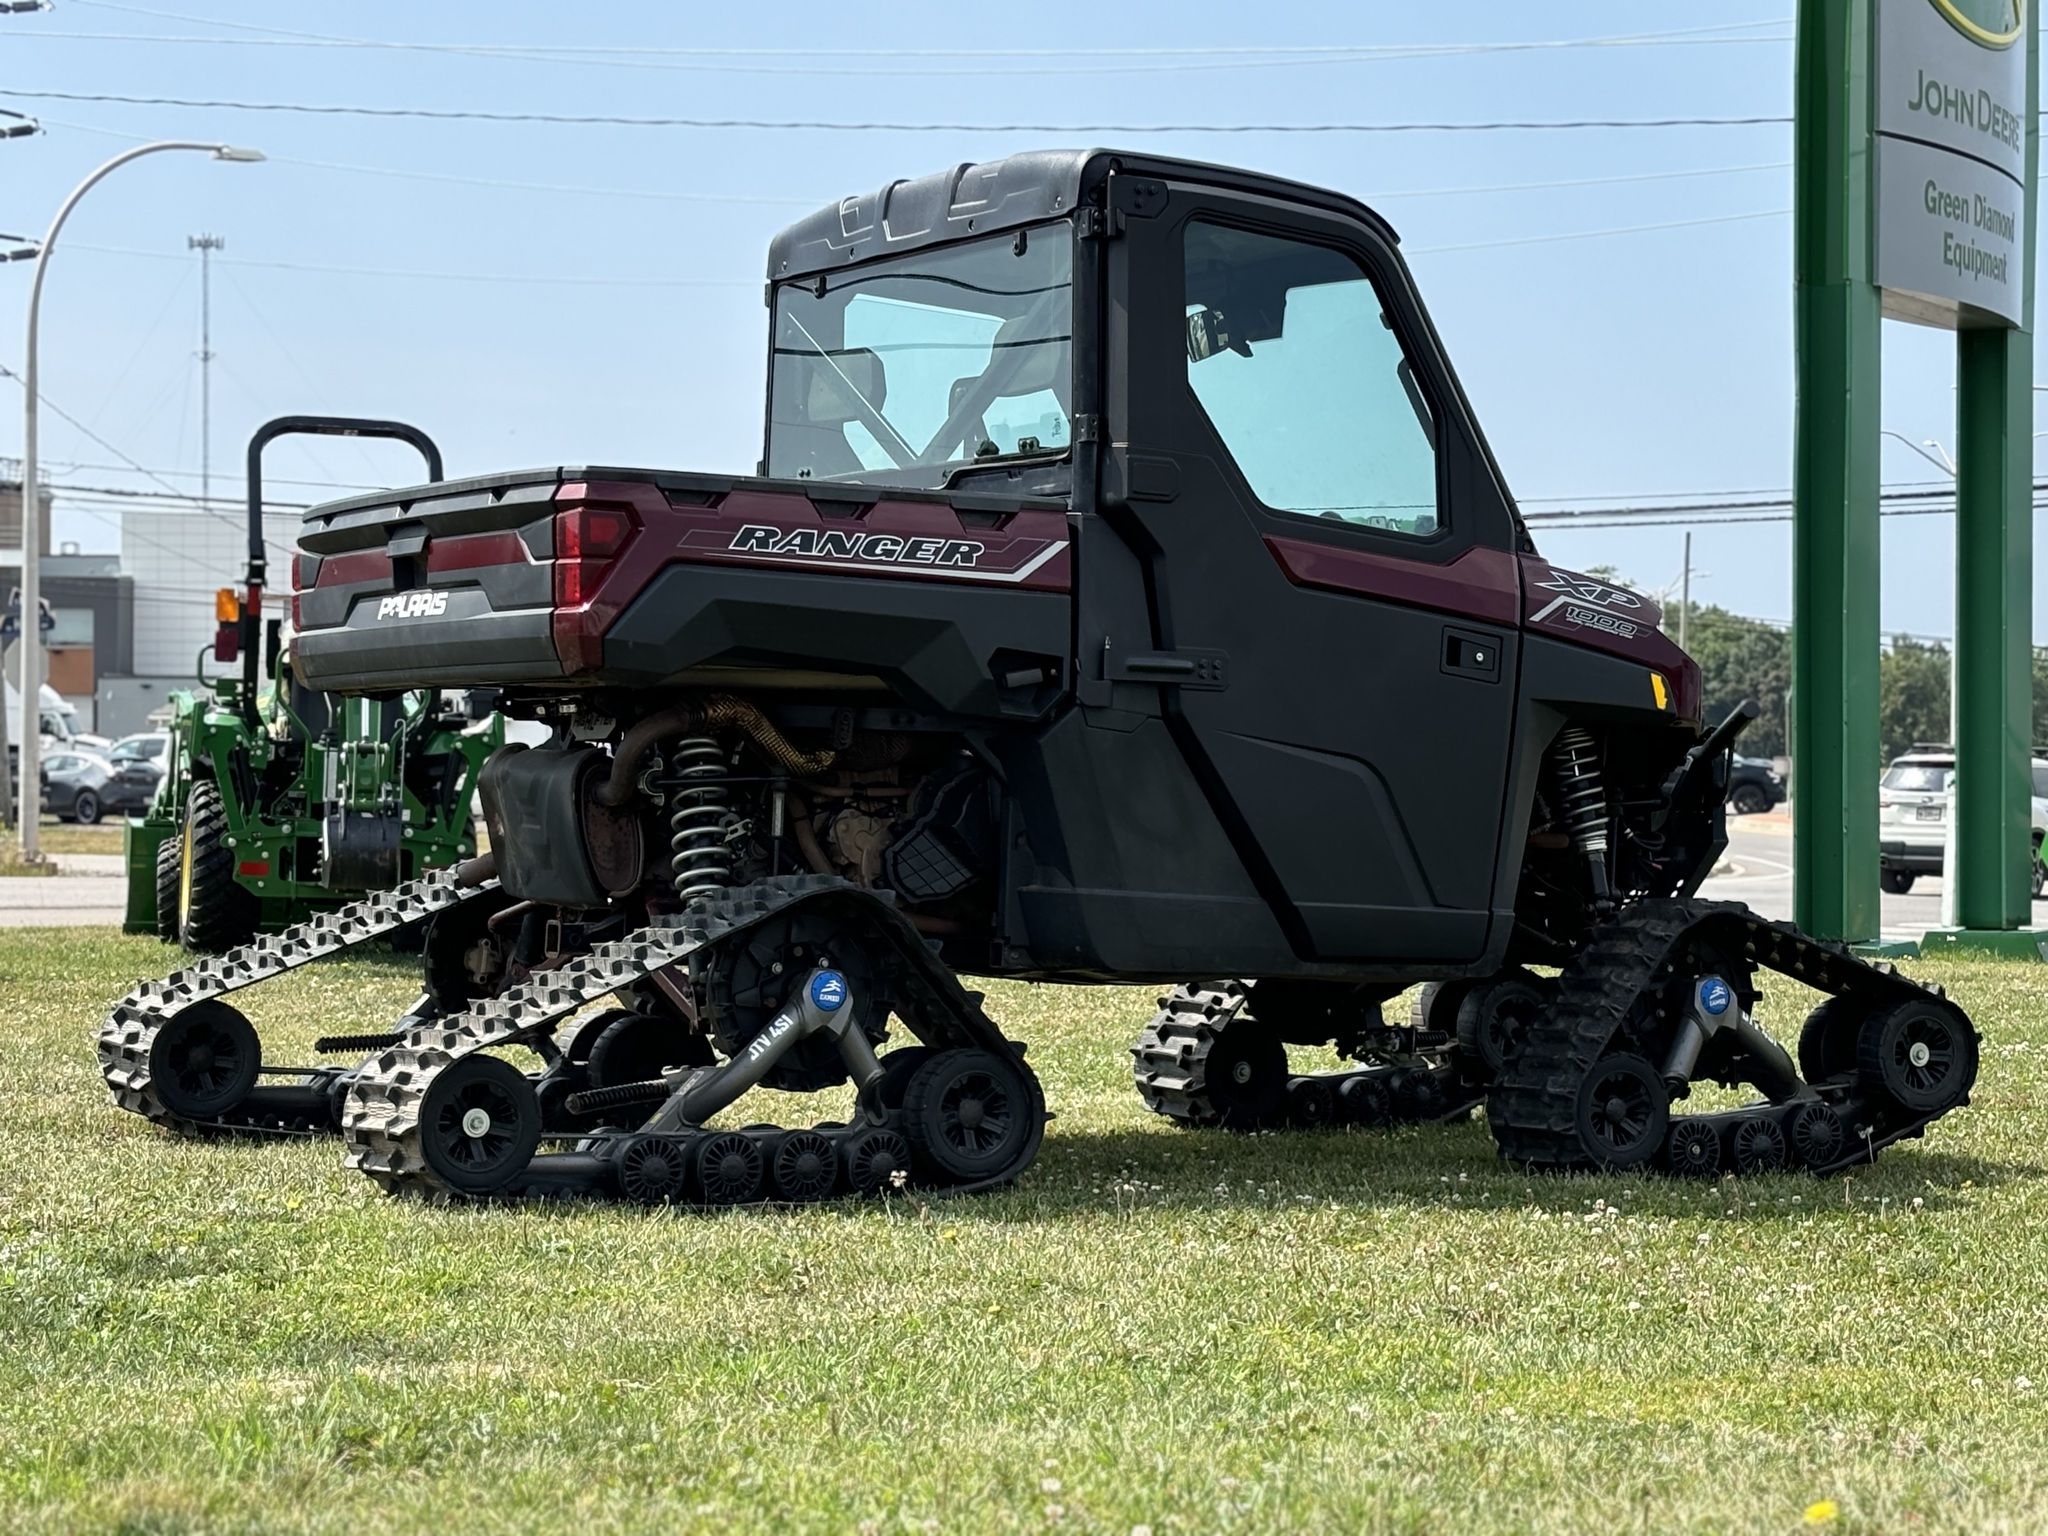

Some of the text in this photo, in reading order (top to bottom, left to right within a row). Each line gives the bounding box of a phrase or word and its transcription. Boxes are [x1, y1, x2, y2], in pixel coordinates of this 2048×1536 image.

[1908, 69, 2019, 154] JOHN DEERE
[1924, 179, 2015, 244] Green Diamond
[1944, 231, 2006, 285] Equipment
[728, 524, 985, 567] RANGER
[377, 592, 449, 621] POLARIS
[1533, 569, 1641, 608] XP
[1565, 606, 1638, 636] 1000
